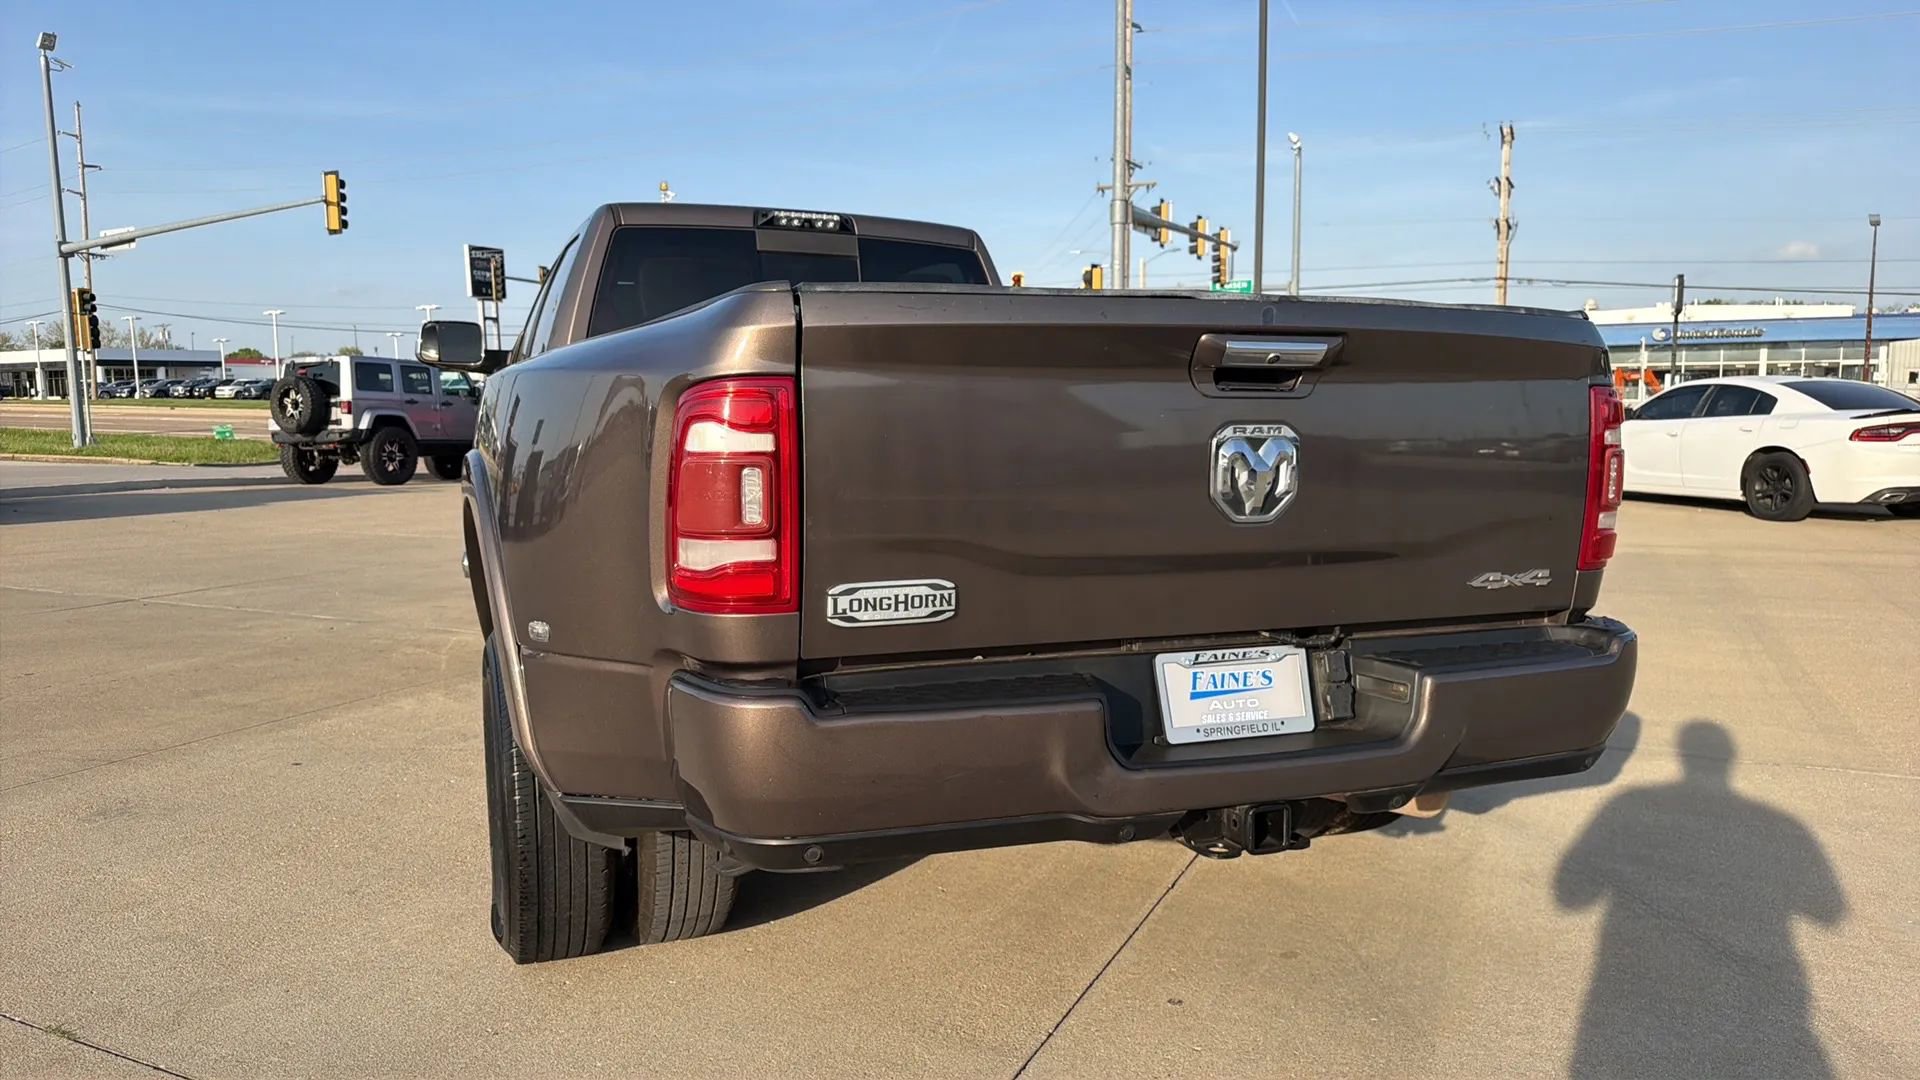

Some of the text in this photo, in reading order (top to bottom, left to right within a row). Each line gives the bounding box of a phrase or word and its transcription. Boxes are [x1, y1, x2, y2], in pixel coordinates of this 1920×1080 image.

[1233, 426, 1282, 434] RAM
[1193, 649, 1271, 662] FAINE'S
[1191, 669, 1273, 690] FAINE'S
[1209, 698, 1259, 710] AUTO
[1201, 713, 1226, 724] SALES
[1235, 710, 1269, 721] SERVICE
[1203, 722, 1280, 737] SPRINGFIELD IL
